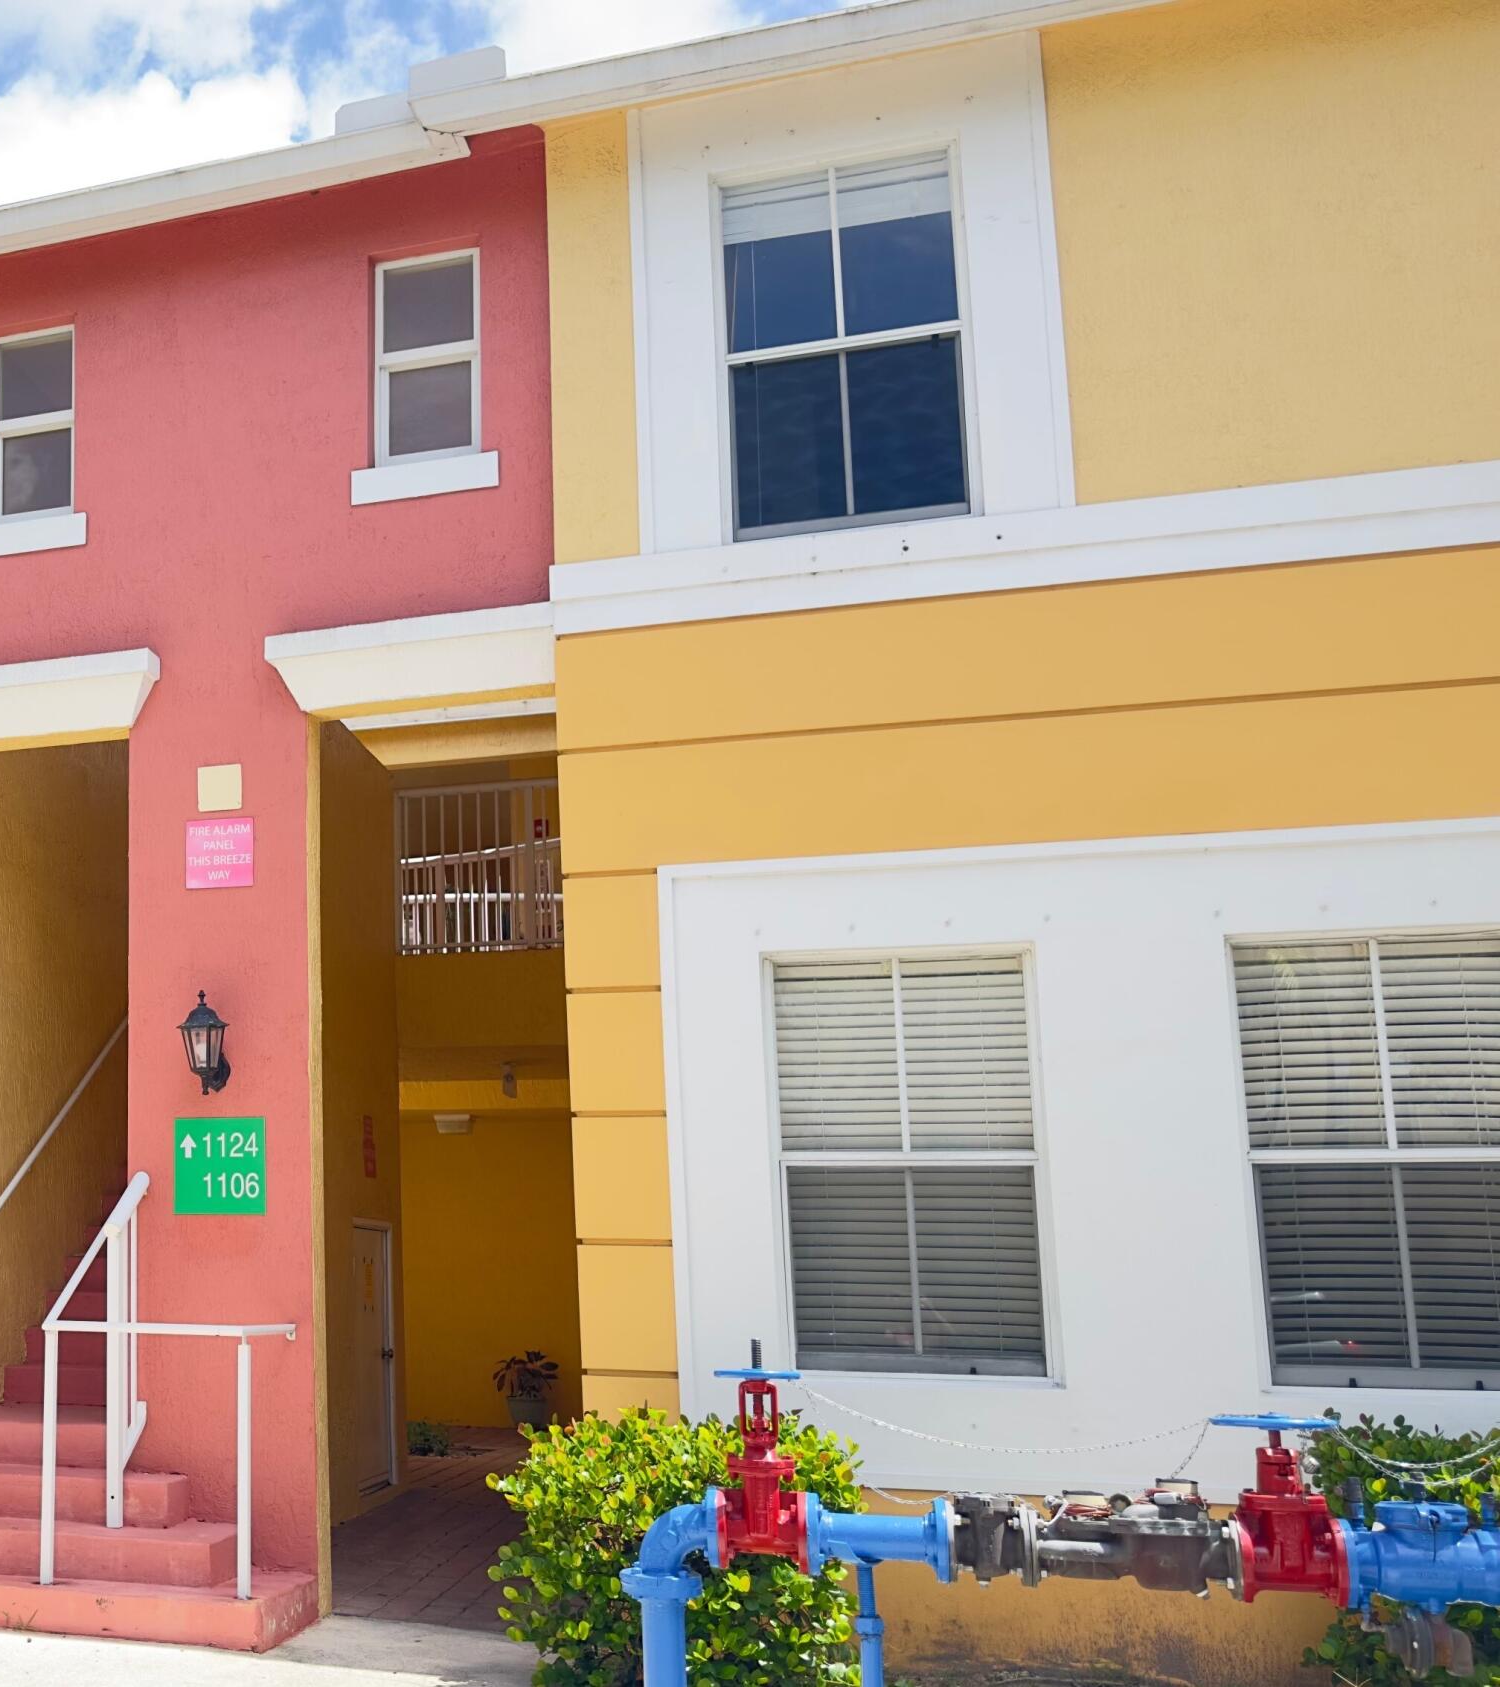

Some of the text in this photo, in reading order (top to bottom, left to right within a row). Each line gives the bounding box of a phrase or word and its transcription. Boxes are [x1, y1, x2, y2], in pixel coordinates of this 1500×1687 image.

[189, 824, 250, 837] FIRE ALARM
[203, 839, 236, 851] PANEL
[188, 853, 252, 866] THIS BREEZE
[207, 870, 230, 880] WAY
[202, 1132, 259, 1158] 1124
[203, 1172, 260, 1199] 1106
